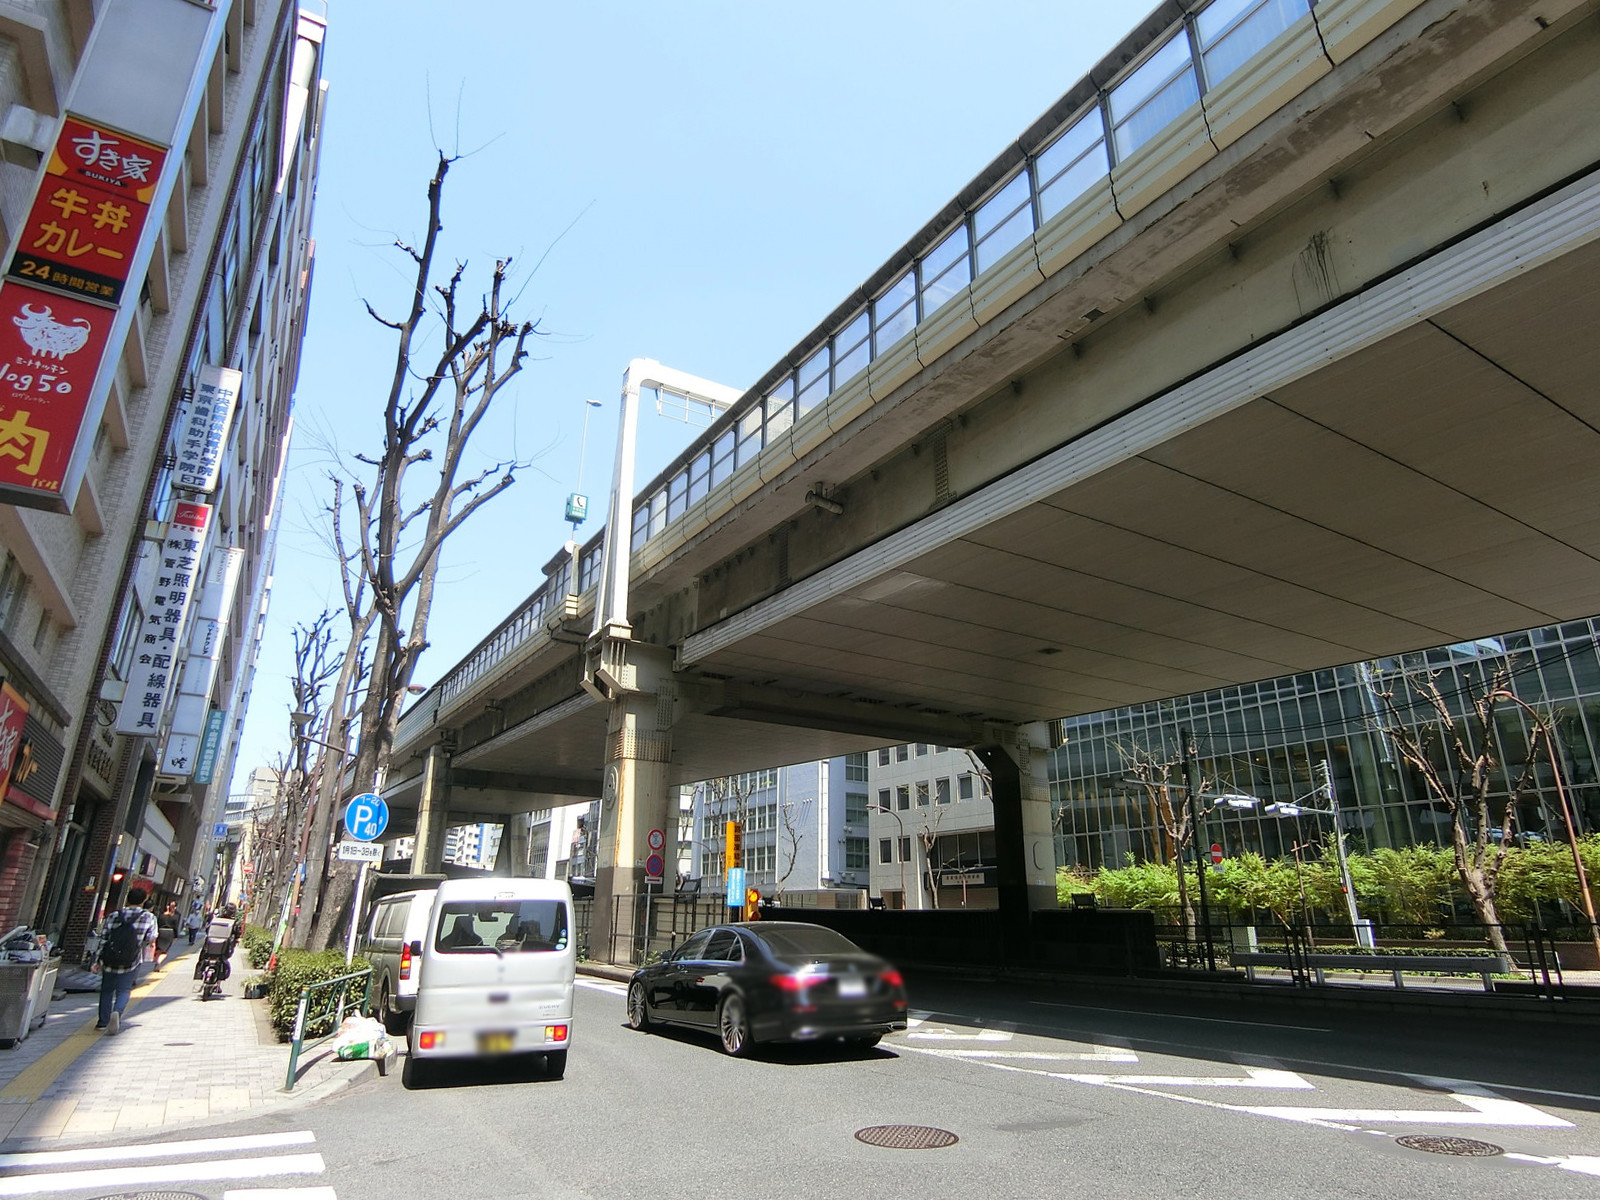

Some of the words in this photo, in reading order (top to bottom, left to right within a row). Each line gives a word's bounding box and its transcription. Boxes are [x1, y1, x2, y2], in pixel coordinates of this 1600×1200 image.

[72, 131, 152, 182] すき家
[85, 171, 122, 187] SUKIYA
[50, 188, 131, 234] 牛丼
[33, 221, 125, 260] カレー
[19, 260, 115, 297] 24時間営業
[16, 356, 68, 375] ミートキッチン
[353, 805, 373, 834] P
[364, 822, 378, 836] 40
